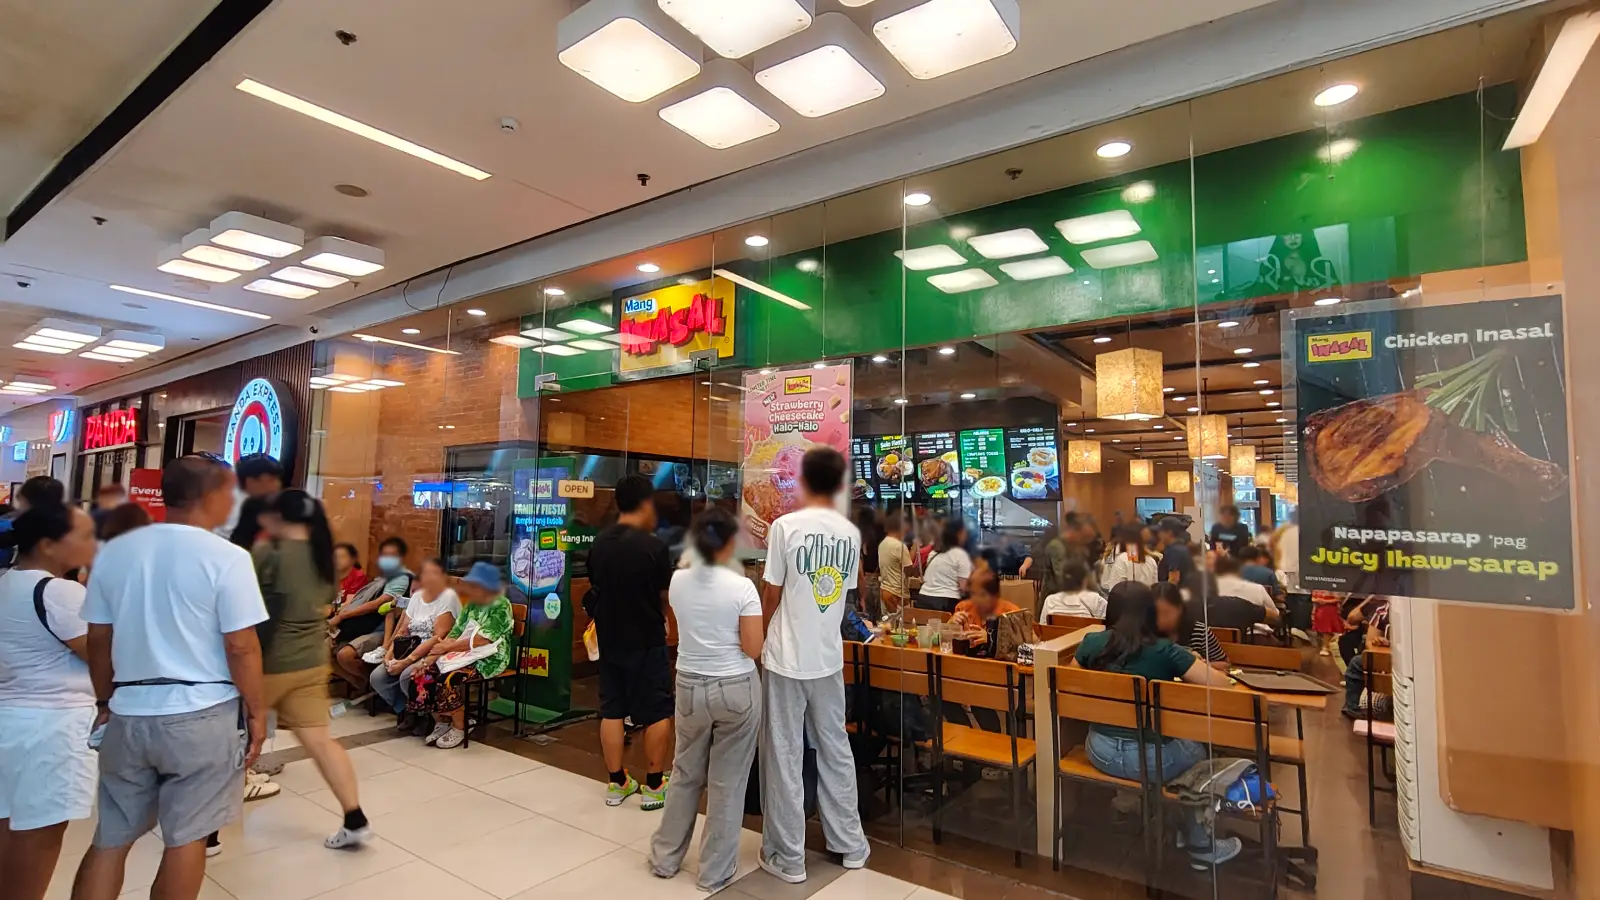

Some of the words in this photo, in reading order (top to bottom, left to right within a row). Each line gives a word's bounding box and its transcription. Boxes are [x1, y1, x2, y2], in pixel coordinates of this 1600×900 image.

[624, 299, 653, 312] Mang
[620, 294, 725, 355] INASAL
[1384, 331, 1469, 349] Chicken
[1476, 323, 1553, 343] Inasal
[1311, 337, 1368, 358] INASAL
[228, 390, 251, 443] PANDA
[252, 383, 280, 436] EXPRESS
[769, 411, 825, 422] Cheesecake
[770, 400, 824, 412] Strawberry
[84, 407, 136, 450] PANDA
[773, 422, 819, 432] Halo-Halo
[564, 484, 589, 494] OPEN
[541, 504, 567, 516] FIESTA
[1334, 527, 1480, 548] Napapasarap
[1311, 547, 1379, 571] Juicy
[1387, 550, 1559, 581] Ihaw-sarap
